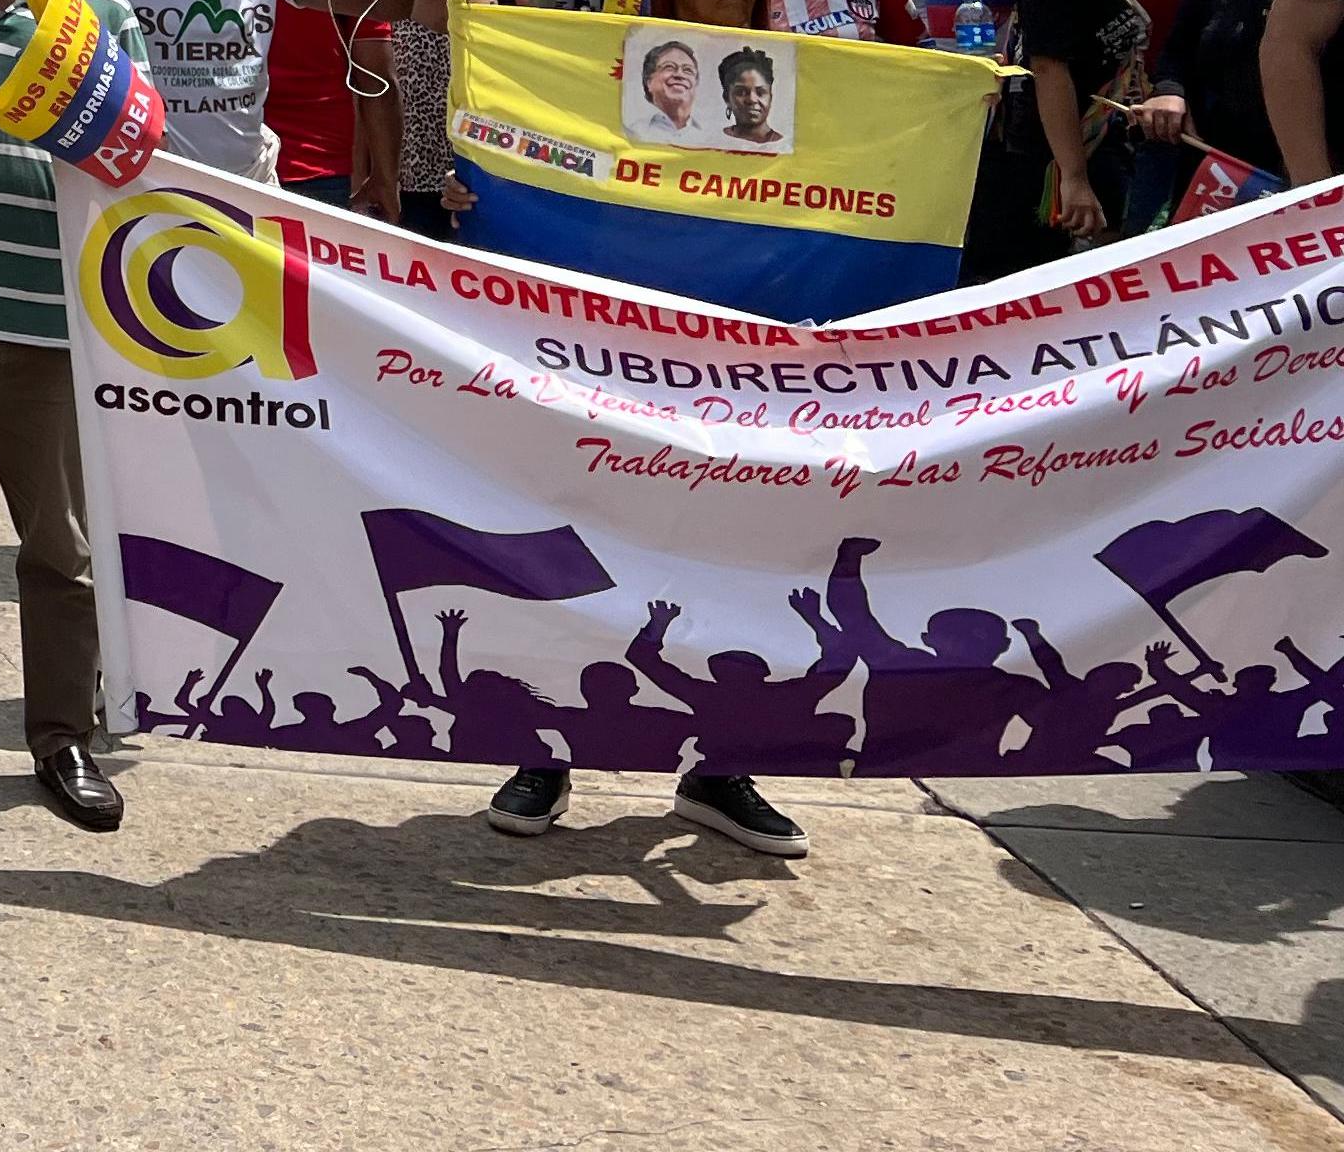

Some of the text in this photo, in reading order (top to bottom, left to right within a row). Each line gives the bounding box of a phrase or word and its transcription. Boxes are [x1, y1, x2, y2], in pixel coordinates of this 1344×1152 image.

[47, 88, 73, 119] EN
[67, 31, 100, 88] APOYO
[154, 40, 263, 62] TIERRA
[57, 65, 117, 150] REFORMAS
[615, 159, 897, 218] DE CAMPEONES
[309, 234, 368, 277] DE
[378, 252, 439, 294] LA
[812, 298, 1064, 343] GENERAL
[1073, 267, 1151, 312] DE
[1159, 252, 1238, 295] LA
[93, 380, 332, 432] ascontrol
[376, 348, 444, 389] Por
[456, 362, 520, 402] La
[695, 394, 770, 430] Del
[788, 400, 933, 436] Control
[945, 379, 1079, 424] Fiscal
[1105, 366, 1148, 415] Y
[1165, 354, 1239, 396] Los
[534, 335, 1013, 395] SUBDIRECTIVA
[574, 407, 1344, 499] Trabajdores Y Las Reformas Sociales
